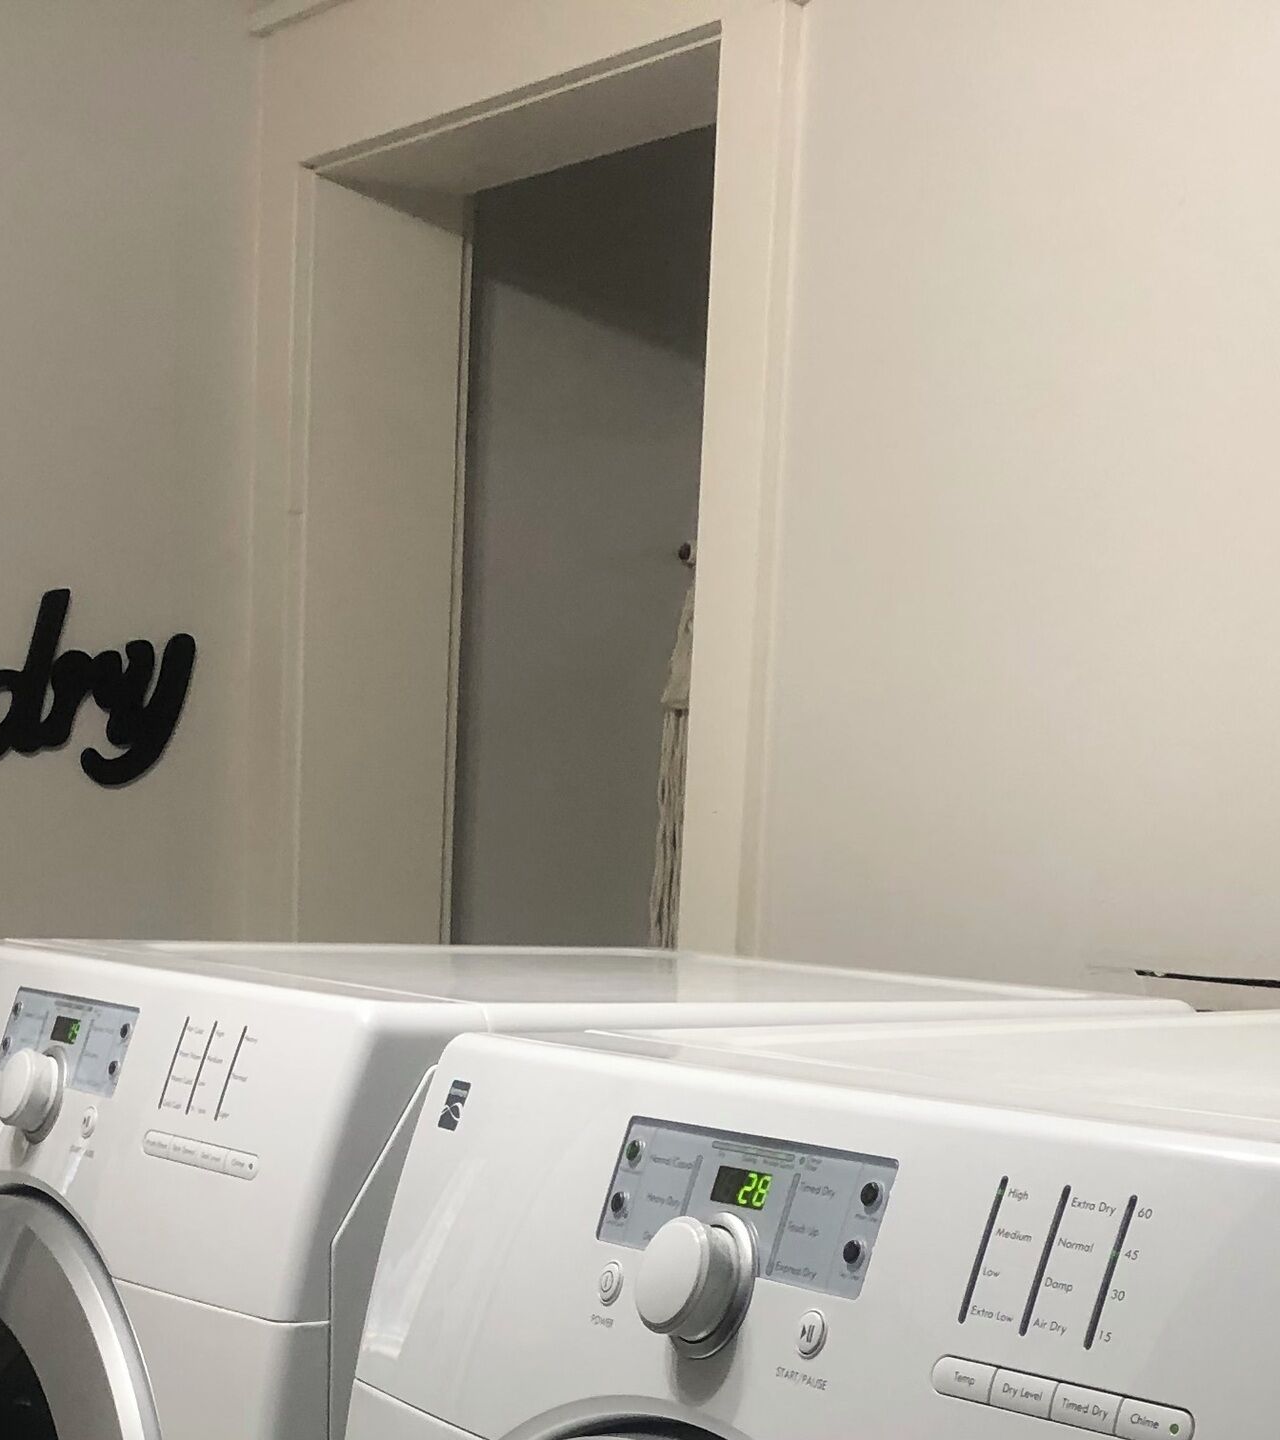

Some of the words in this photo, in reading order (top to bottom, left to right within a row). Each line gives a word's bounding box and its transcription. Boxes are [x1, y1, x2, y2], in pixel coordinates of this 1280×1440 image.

[737, 1173, 772, 1207] 28
[821, 1185, 836, 1198] Dry
[1007, 1187, 1029, 1202] High
[1071, 1197, 1096, 1211] Extra
[1098, 1202, 1117, 1216] Dry
[1137, 1208, 1153, 1219] 60
[995, 1228, 1032, 1243] Medium
[1057, 1237, 1095, 1252] Normal
[1124, 1250, 1139, 1260] 45
[803, 1266, 817, 1280] Dry
[983, 1267, 1001, 1278] Low
[1044, 1276, 1073, 1293] Damp
[1110, 1289, 1126, 1301] 30
[590, 1313, 614, 1329] POWER
[970, 1305, 994, 1319] Extra
[996, 1311, 1014, 1323] Low
[1033, 1318, 1047, 1329] Air
[1050, 1321, 1068, 1337] Dry
[1098, 1331, 1112, 1343] 15
[775, 1366, 828, 1391] START/PAUSE
[953, 1371, 975, 1386] Temp
[1002, 1382, 1018, 1398] Dry
[1020, 1387, 1043, 1401] Level
[1062, 1397, 1089, 1415] Timed
[1091, 1404, 1109, 1420] Dry
[1130, 1413, 1160, 1429] Chime
